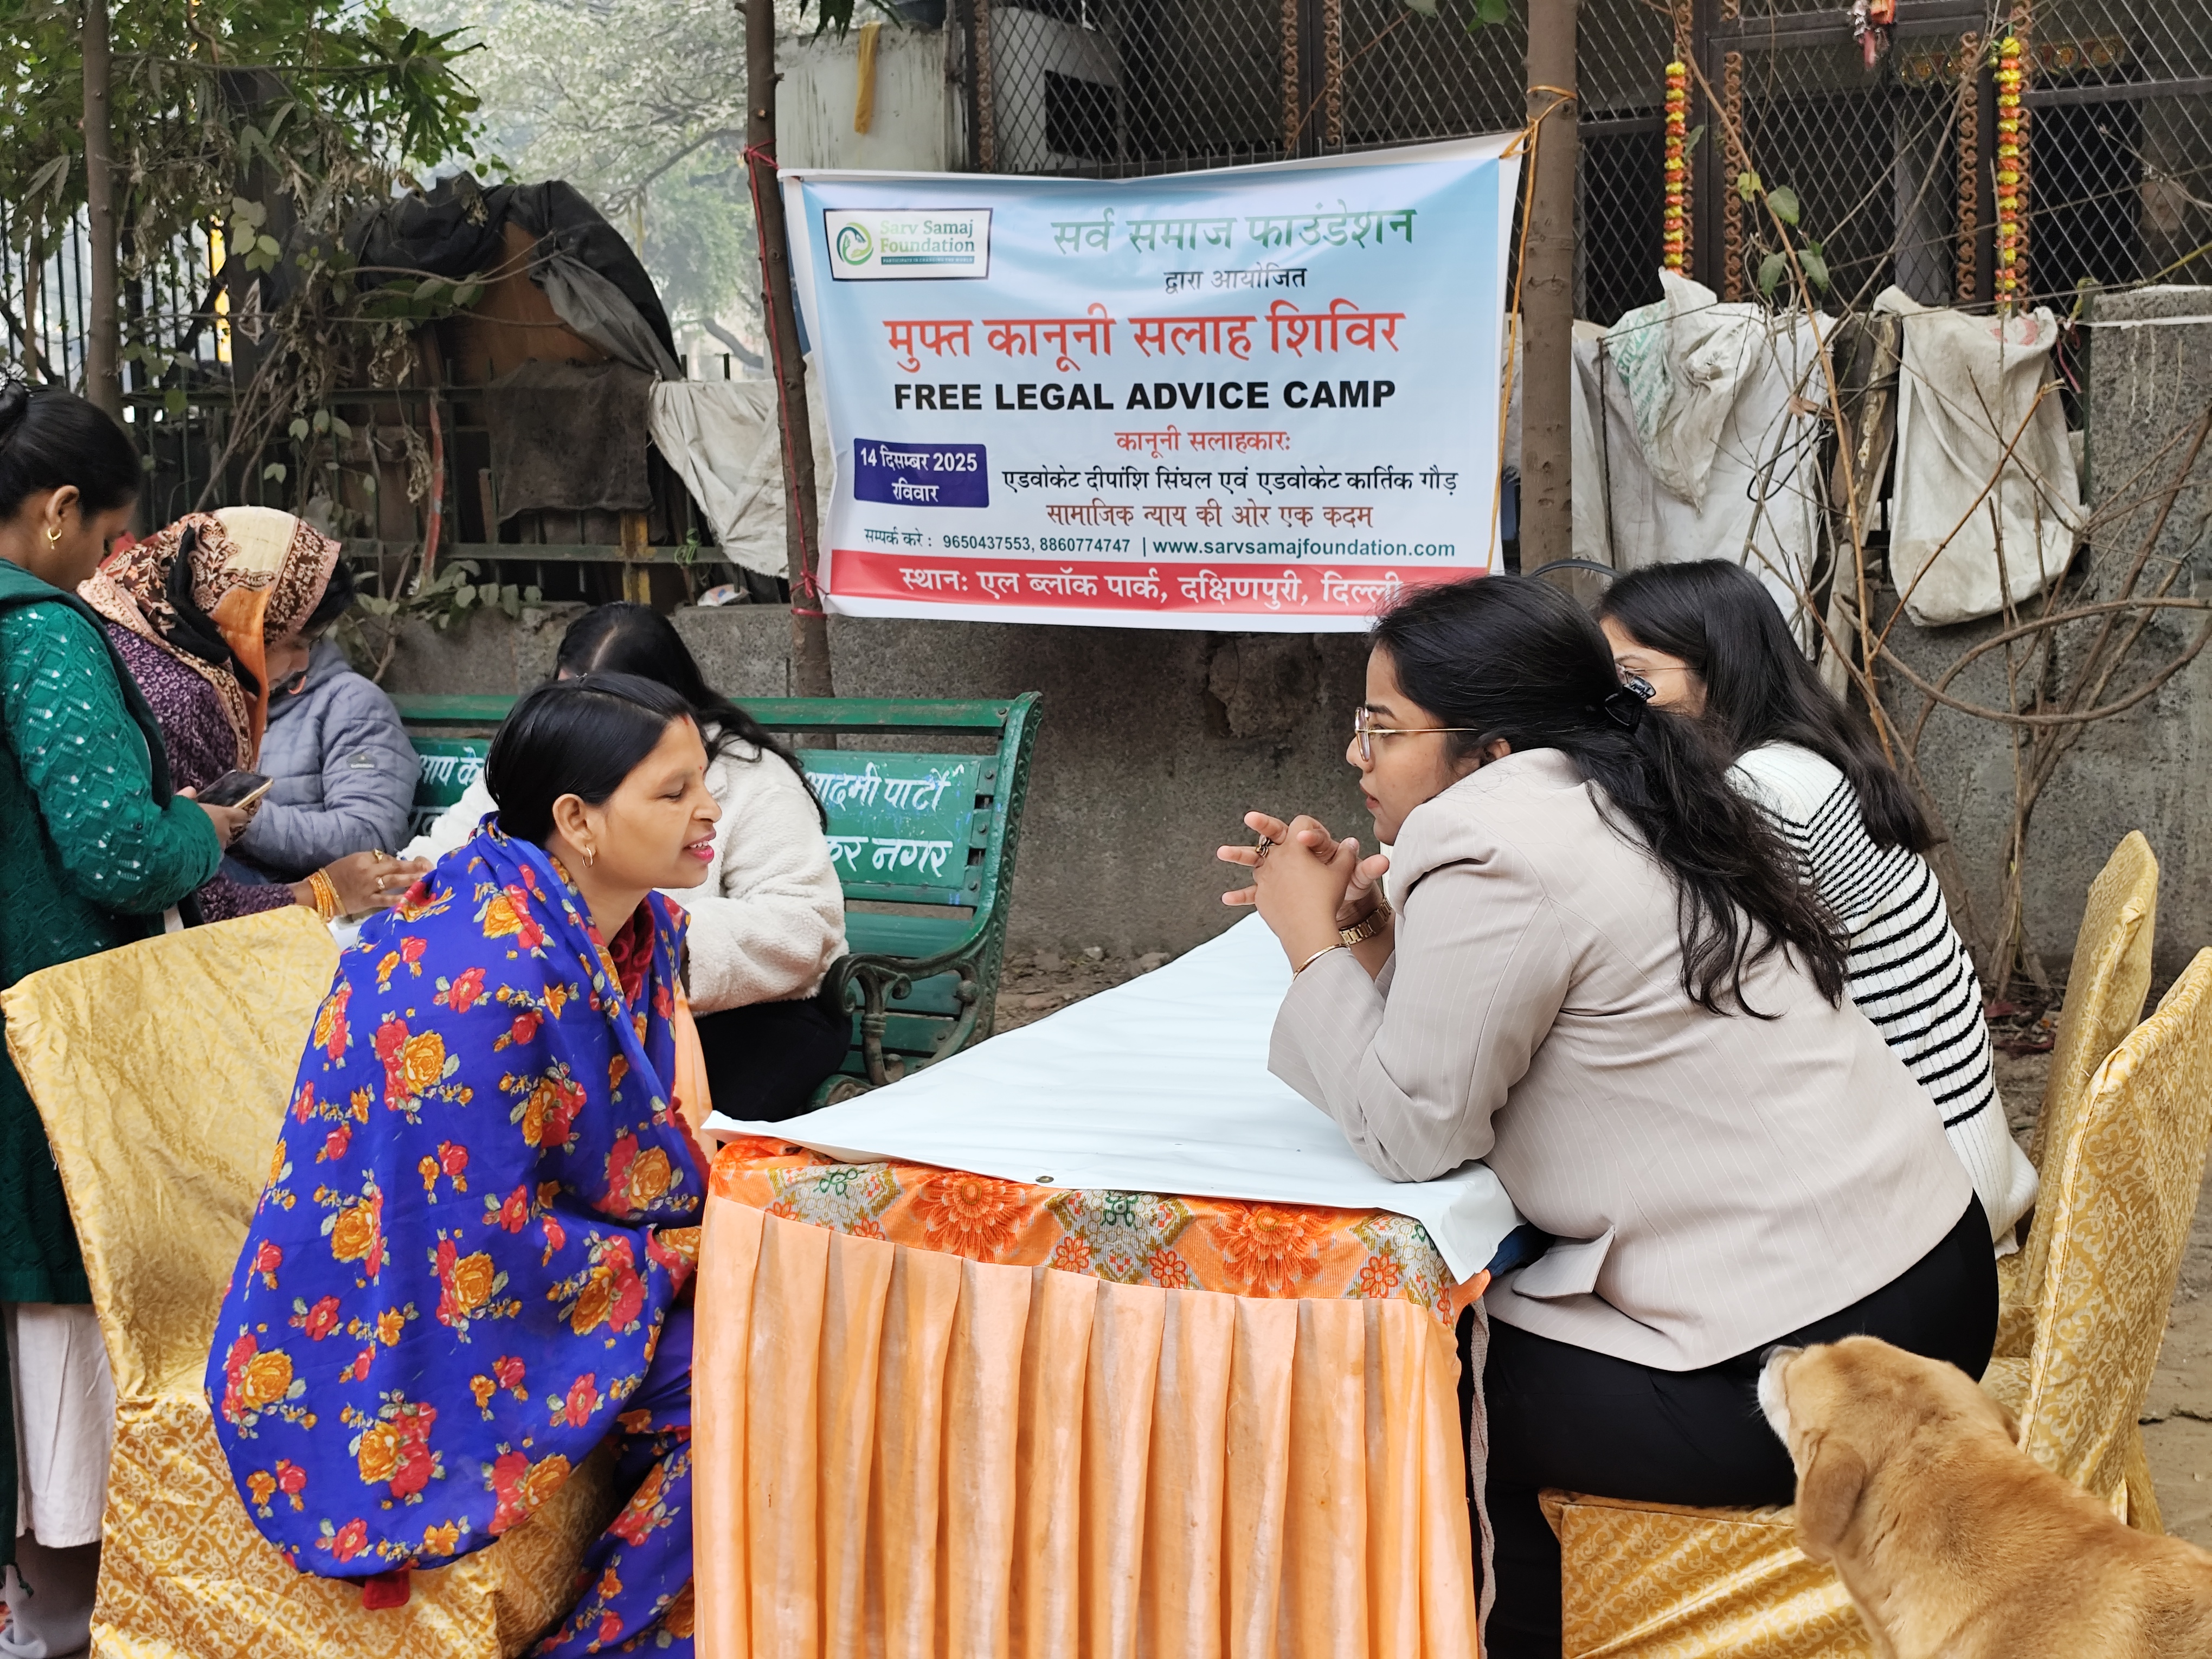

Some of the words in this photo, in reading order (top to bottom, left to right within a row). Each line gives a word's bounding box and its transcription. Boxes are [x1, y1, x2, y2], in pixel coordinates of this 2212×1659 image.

[880, 220, 919, 235] Sarv
[923, 219, 974, 238] Samaj
[1050, 207, 1115, 255] सर्व
[1127, 217, 1237, 254] समाज
[1244, 199, 1418, 249] फाउंडेशन
[880, 237, 975, 253] Foundation
[1163, 271, 1204, 294] द्वारा
[1211, 262, 1308, 290] आयोजित
[882, 320, 974, 374] मुफ्त
[981, 303, 1117, 373] कानूनी
[1128, 316, 1257, 361] सलाह
[1265, 298, 1406, 358] शिविर
[895, 383, 982, 410] FREE
[995, 383, 1114, 410] LEGAL
[1126, 382, 1269, 410] ADVICE
[1283, 380, 1396, 409] CAMP
[1114, 425, 1181, 459] कानूनी
[860, 447, 877, 467] 14
[880, 444, 930, 471] दिसम्बर
[933, 453, 978, 472] 2025
[891, 477, 940, 502] रविवार
[1002, 465, 1081, 493] एडवोकेट
[1084, 466, 1150, 491] दीपांशि
[1155, 466, 1212, 490] सिंघल
[1218, 466, 1249, 494] एवं
[1256, 465, 1342, 495] एडवोकेट
[1345, 465, 1414, 491] कार्तिक
[1419, 465, 1459, 496] गौड़
[1046, 498, 1134, 526] सामाजिक
[1142, 505, 1187, 527] न्याय
[1196, 498, 1223, 527] की
[1231, 498, 1271, 528] ओर
[1278, 506, 1314, 528] एक
[1322, 506, 1374, 528] कदम
[864, 526, 899, 545] सम्पर्क
[943, 535, 1034, 554] 9650437553,
[1040, 537, 1130, 553] 8860774747
[1153, 538, 1455, 559] www.sarvsamajfoundation.com
[975, 571, 1020, 600] एल
[1025, 566, 1098, 596] ब्लॉक
[1104, 567, 1167, 603] पार्क,
[1177, 569, 1308, 610] दक्षिणपुरी,
[1320, 570, 1404, 607] दिल्ली
[871, 837, 953, 878] नगर
